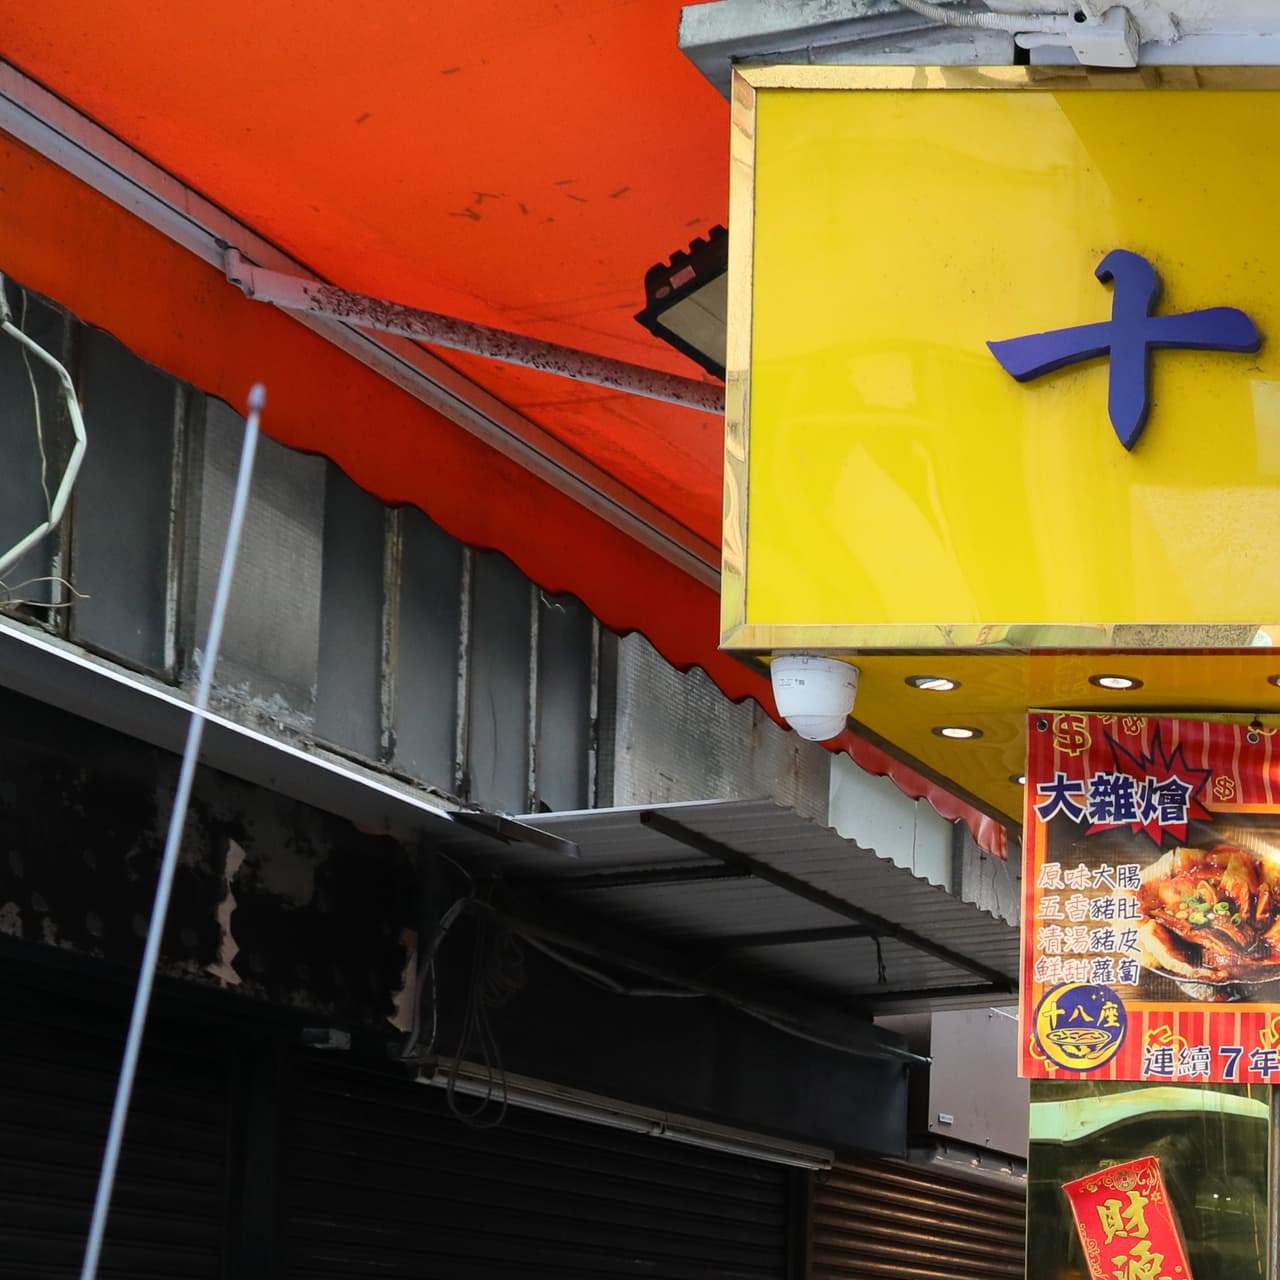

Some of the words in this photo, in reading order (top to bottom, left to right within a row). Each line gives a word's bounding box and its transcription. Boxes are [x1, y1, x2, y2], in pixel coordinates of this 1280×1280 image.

[1035, 771, 1192, 827] 大雜燴
[1035, 863, 1143, 891] 原味大腸
[1036, 895, 1144, 922] 五香豬肚
[1035, 926, 1142, 954] 清湯豬皮
[1034, 956, 1141, 986] 鮮甜蘿蔔
[1040, 1001, 1120, 1030] 十八座
